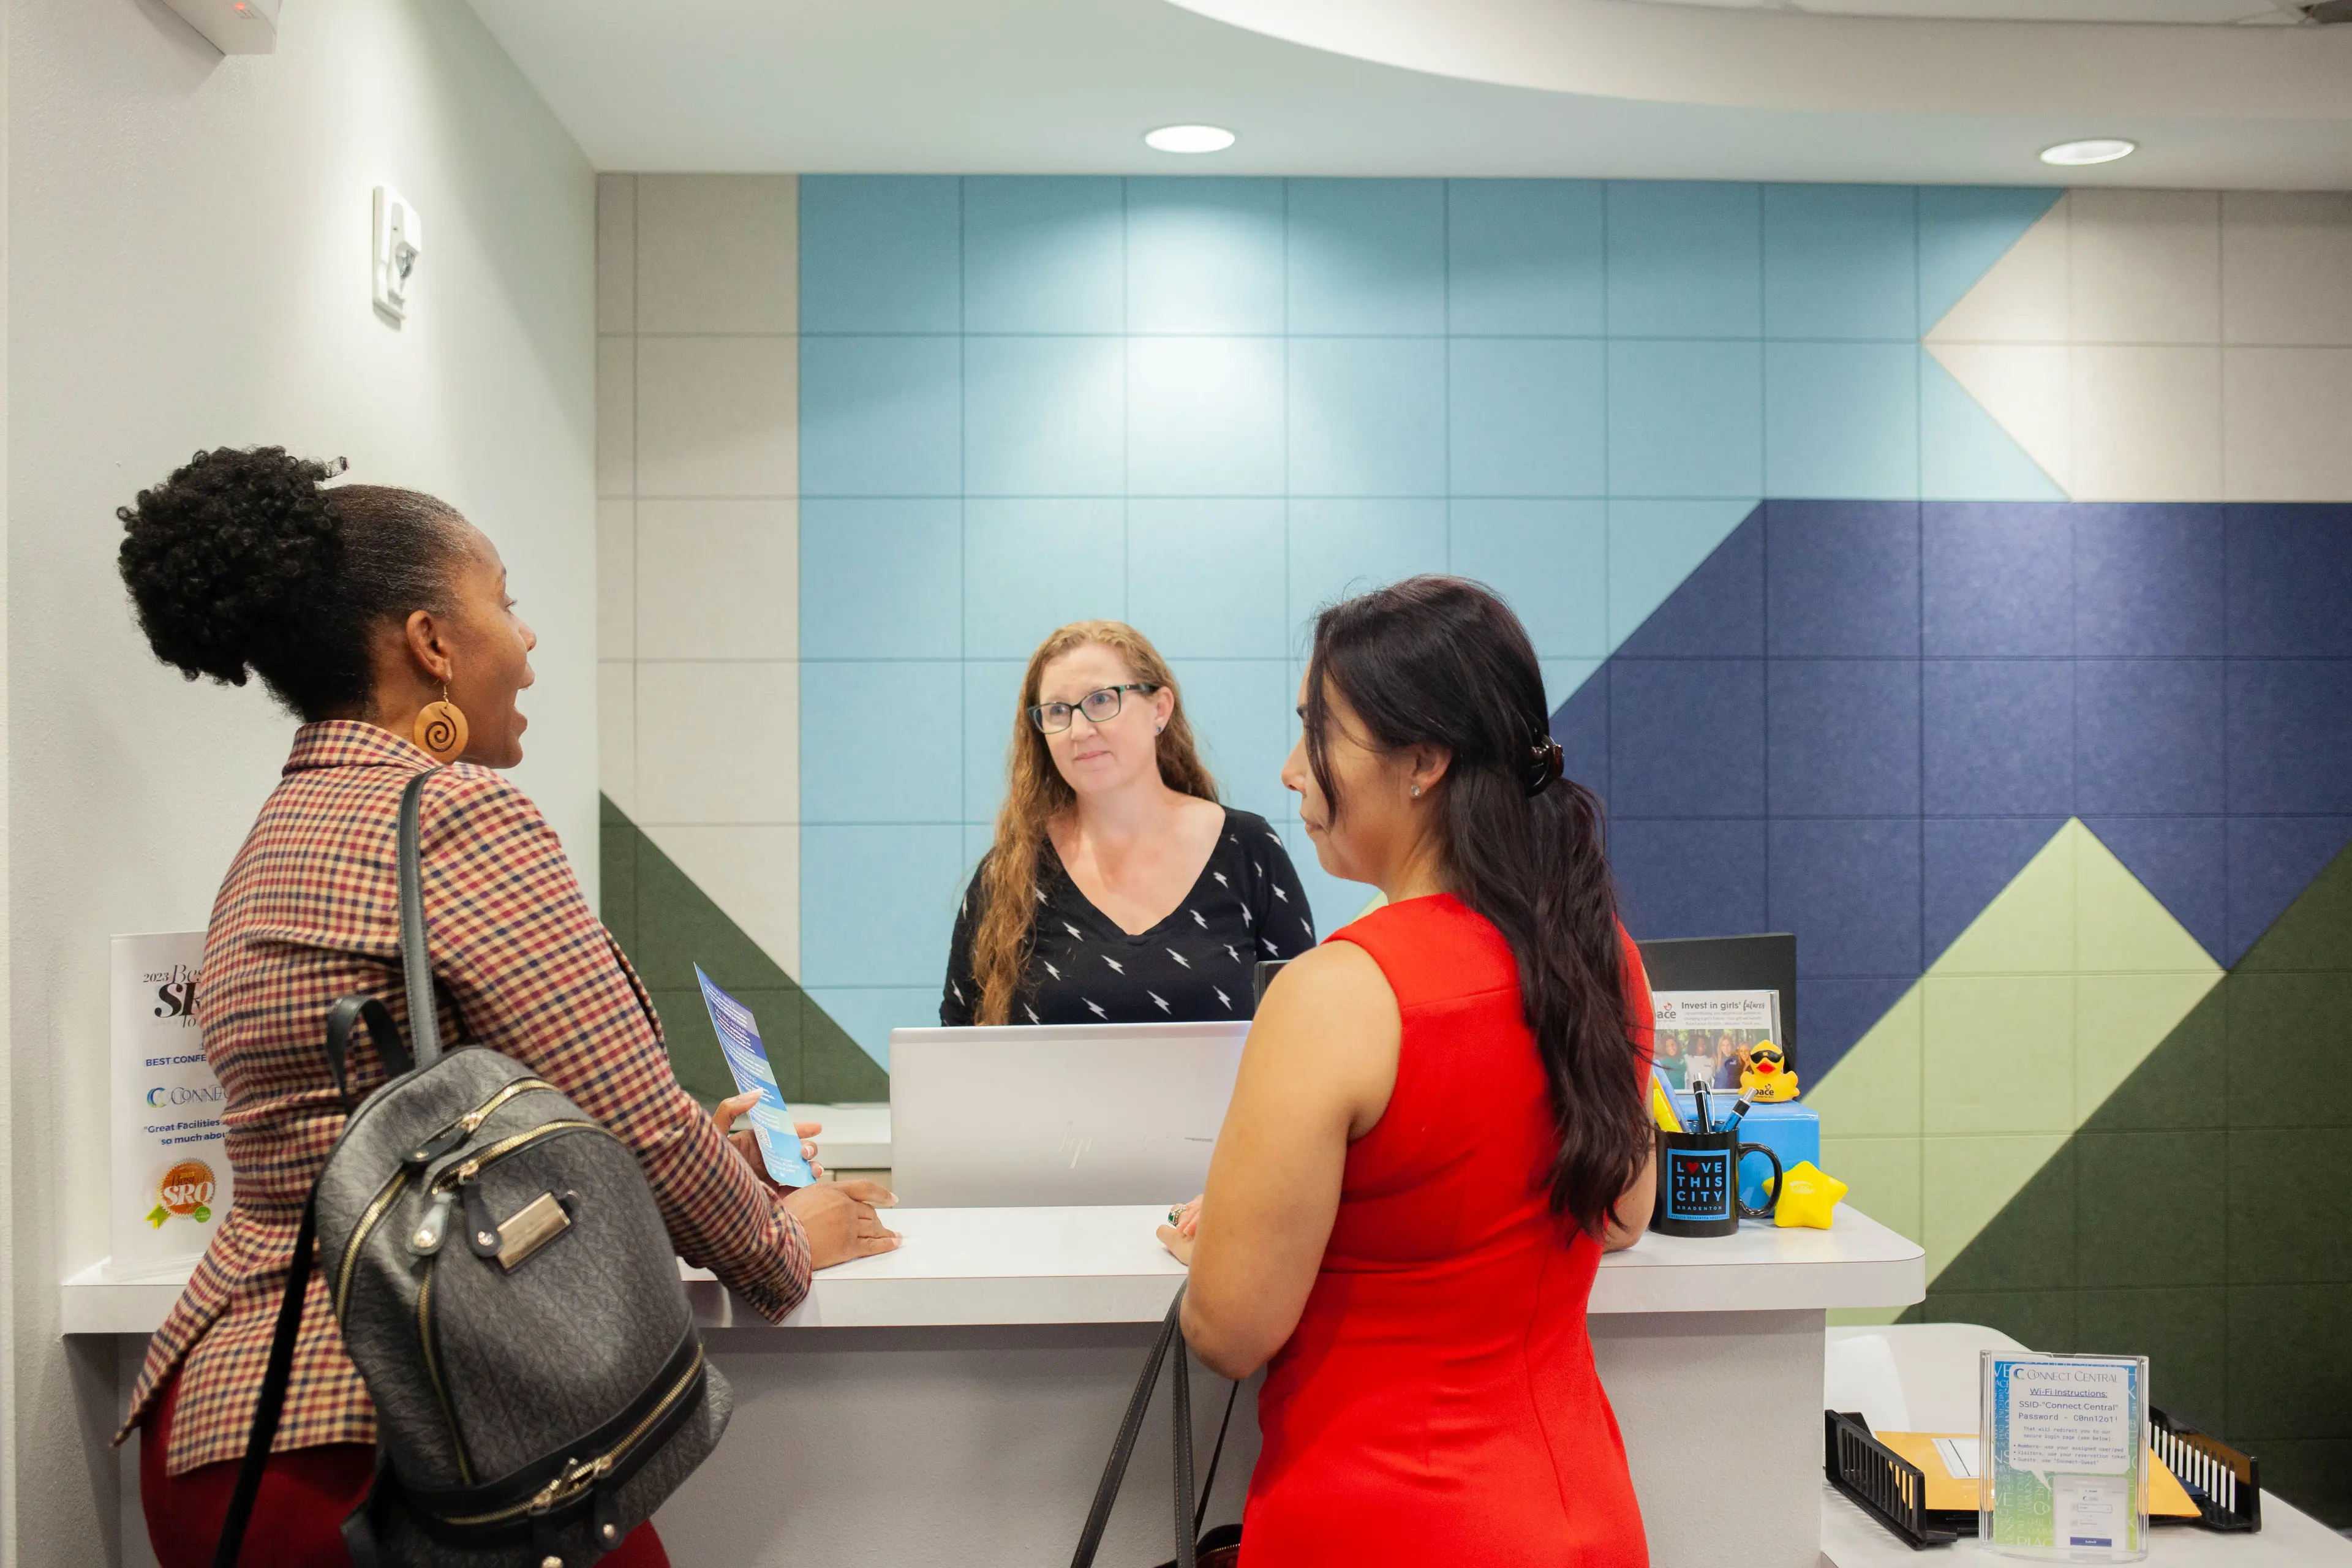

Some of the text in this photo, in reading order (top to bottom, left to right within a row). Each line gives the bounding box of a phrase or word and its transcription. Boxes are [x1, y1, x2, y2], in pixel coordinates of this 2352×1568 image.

[143, 972, 169, 983] 2023
[1681, 1001, 1708, 1010] Invest
[1721, 1001, 1741, 1011] girls'
[1743, 1000, 1765, 1011] futures
[146, 1054, 206, 1066] BEST CONFE
[144, 1119, 221, 1133] "Great Facilities
[175, 1134, 202, 1144] much
[1676, 1176, 1722, 1188] THIS
[1676, 1191, 1722, 1202] CITY
[2027, 1369, 2070, 1381] CONNECT
[2075, 1371, 2120, 1383] CENTRAL
[2055, 1389, 2108, 1398] Instructions:
[2019, 1401, 2081, 1409] SSID-"Connect
